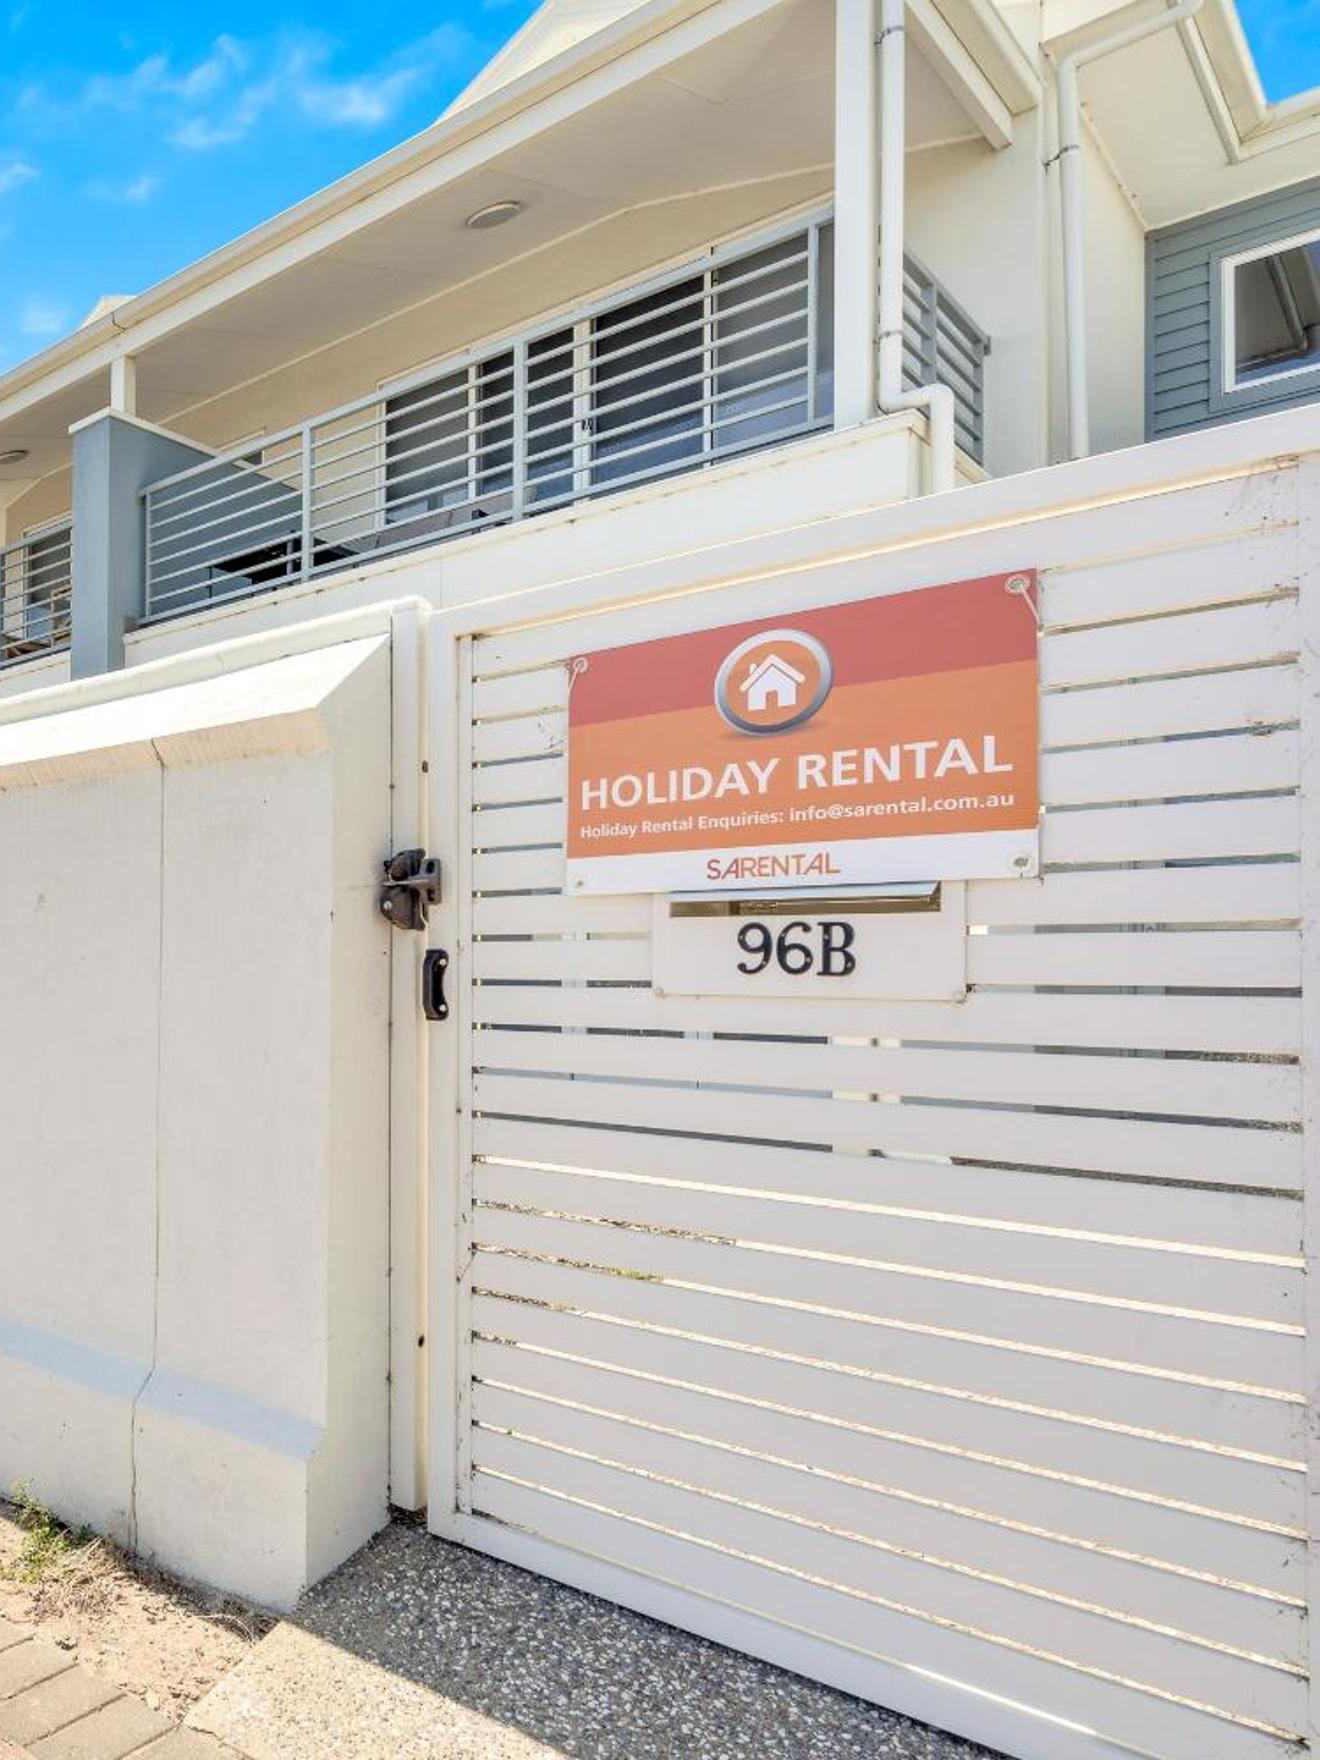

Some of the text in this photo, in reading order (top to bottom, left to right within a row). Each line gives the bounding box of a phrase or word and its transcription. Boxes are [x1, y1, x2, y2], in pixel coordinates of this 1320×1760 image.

[581, 735, 1014, 811] HOLIDAY RENTAL
[580, 793, 1015, 839] Holiday Rental Enquiries: info@sarental.com.au
[706, 852, 842, 881] SARENTAL
[736, 921, 856, 976] 96B
